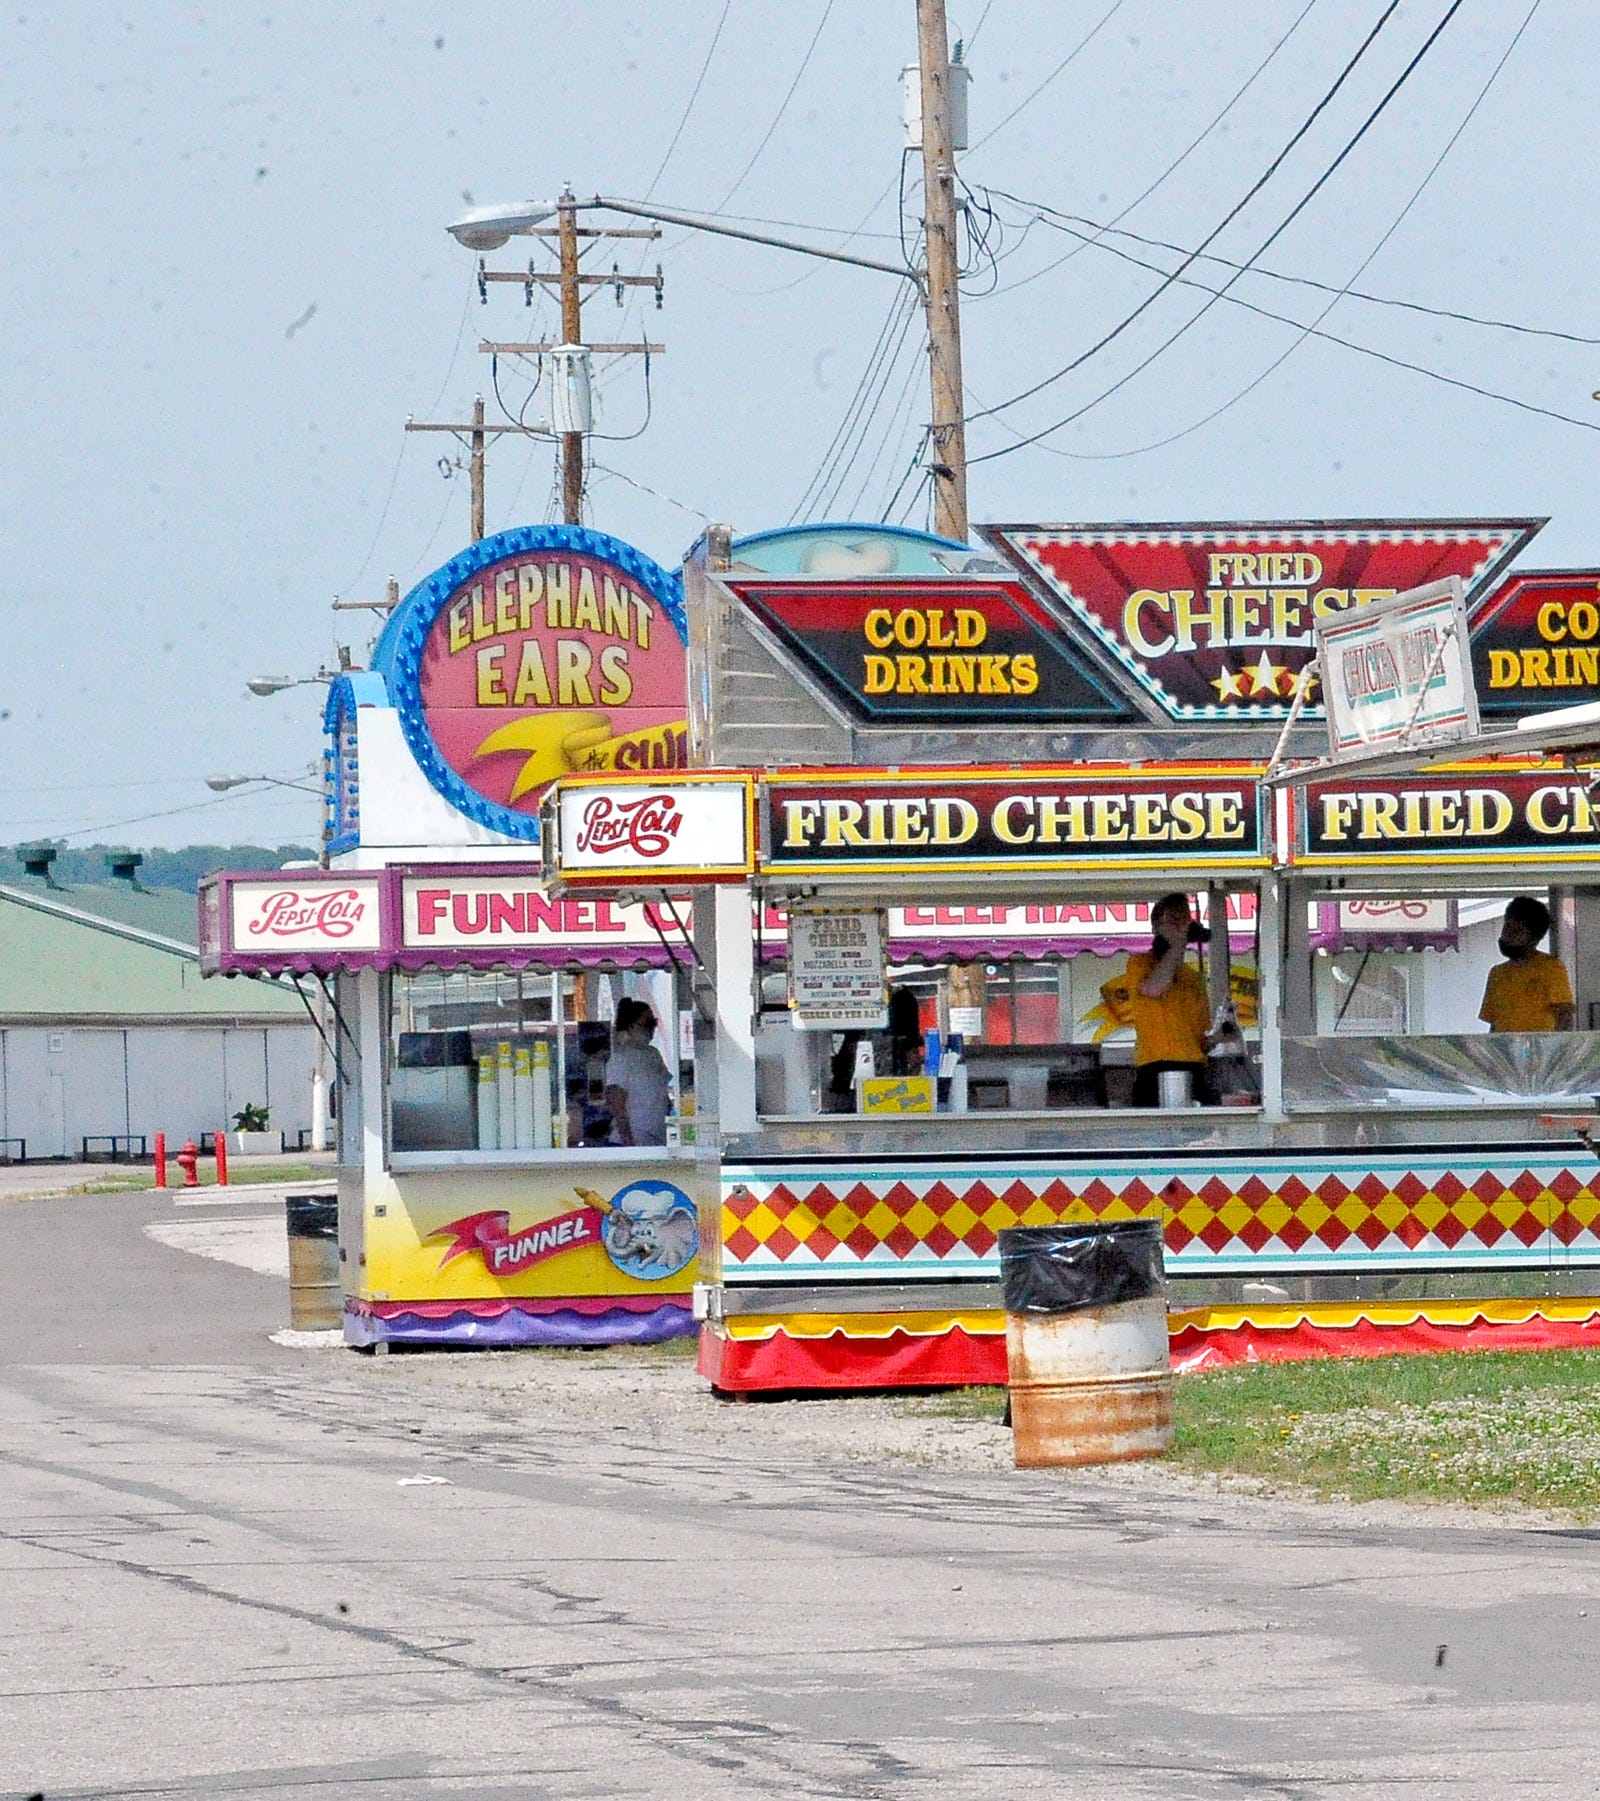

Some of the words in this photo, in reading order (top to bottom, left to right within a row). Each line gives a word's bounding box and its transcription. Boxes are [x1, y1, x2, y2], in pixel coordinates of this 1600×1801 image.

[1207, 552, 1323, 586] FRIED
[449, 562, 653, 655] ELEPHANT
[864, 608, 987, 648] COLD
[1122, 588, 1397, 658] CHEE
[476, 638, 633, 706] EARS
[863, 653, 1040, 694] DRINKS
[782, 798, 979, 848] FRIED
[992, 791, 1246, 845] CHEESE
[1320, 789, 1513, 841] FRIED
[417, 890, 626, 934] FUNNEL
[494, 1217, 591, 1269] FUNNEL
